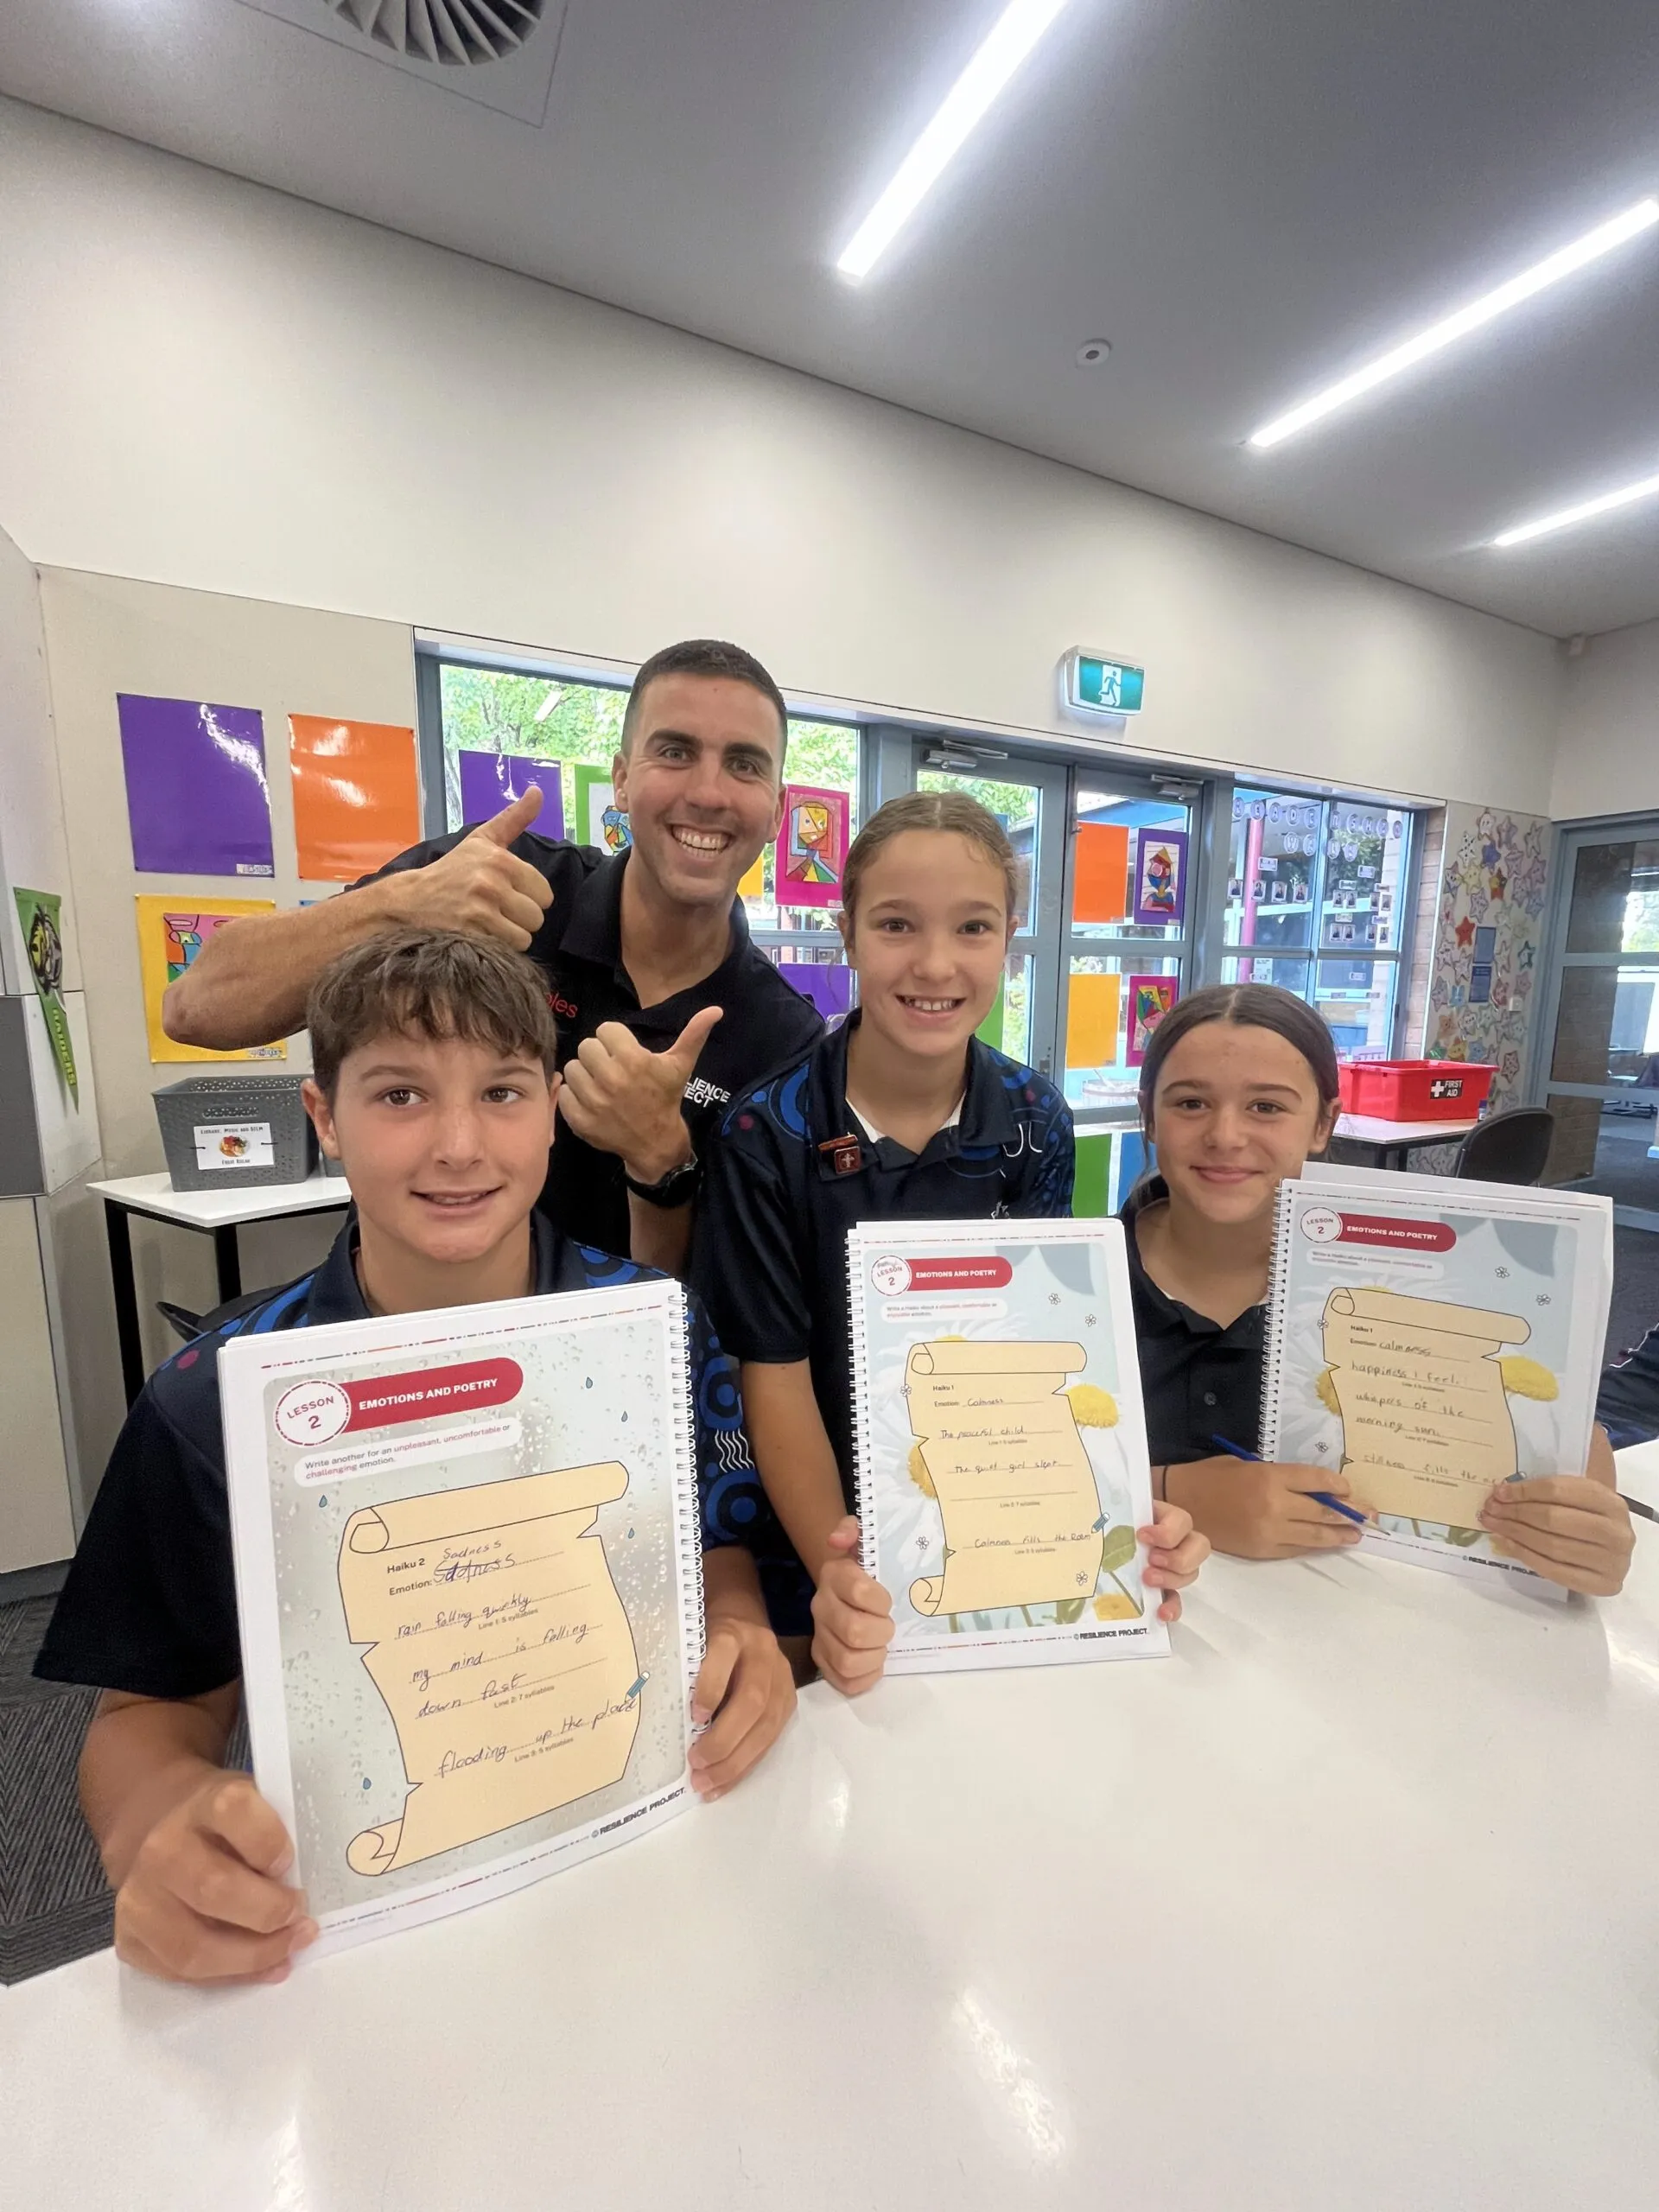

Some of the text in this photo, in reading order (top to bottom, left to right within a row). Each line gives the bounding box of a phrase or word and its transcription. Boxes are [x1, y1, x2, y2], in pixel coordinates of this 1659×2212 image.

[1445, 1080, 1462, 1089] FIRST
[683, 1085, 714, 1108] ECT
[1347, 1225, 1387, 1236] EMOTIONS
[1407, 1231, 1438, 1241] POETRY
[877, 1267, 902, 1277] LESSON
[916, 1268, 996, 1279] EMOTIONS AND POETRY
[888, 1277, 895, 1286] 2
[359, 1377, 498, 1410] EMOTIONS AND POETRY
[287, 1395, 334, 1419] LESSON
[1443, 1406, 1465, 1418] the
[308, 1415, 321, 1429] 2
[305, 1458, 329, 1470] Write
[332, 1452, 365, 1465] another
[367, 1448, 379, 1457] for
[382, 1446, 392, 1454] an
[393, 1438, 442, 1453] unpleasant,
[443, 1425, 501, 1444] uncomfortable
[306, 1456, 396, 1480] challenging emotion.
[1055, 1533, 1066, 1542] the
[386, 1558, 425, 1573] Haiku 2
[1468, 1556, 1510, 1570] RESILIENCE
[389, 1578, 433, 1596] Emotion:
[397, 1622, 421, 1637] rain
[478, 1622, 493, 1630] Line
[1079, 1630, 1117, 1640] RESILIENCE
[413, 1667, 430, 1691] my
[450, 1651, 484, 1672] mind
[418, 1699, 461, 1718] down
[494, 1700, 509, 1708] Line
[437, 1744, 508, 1778] flooding
[535, 1729, 552, 1745] up
[560, 1715, 582, 1734] the
[514, 1753, 530, 1763] Line
[600, 1805, 648, 1835] RESILIENCE
